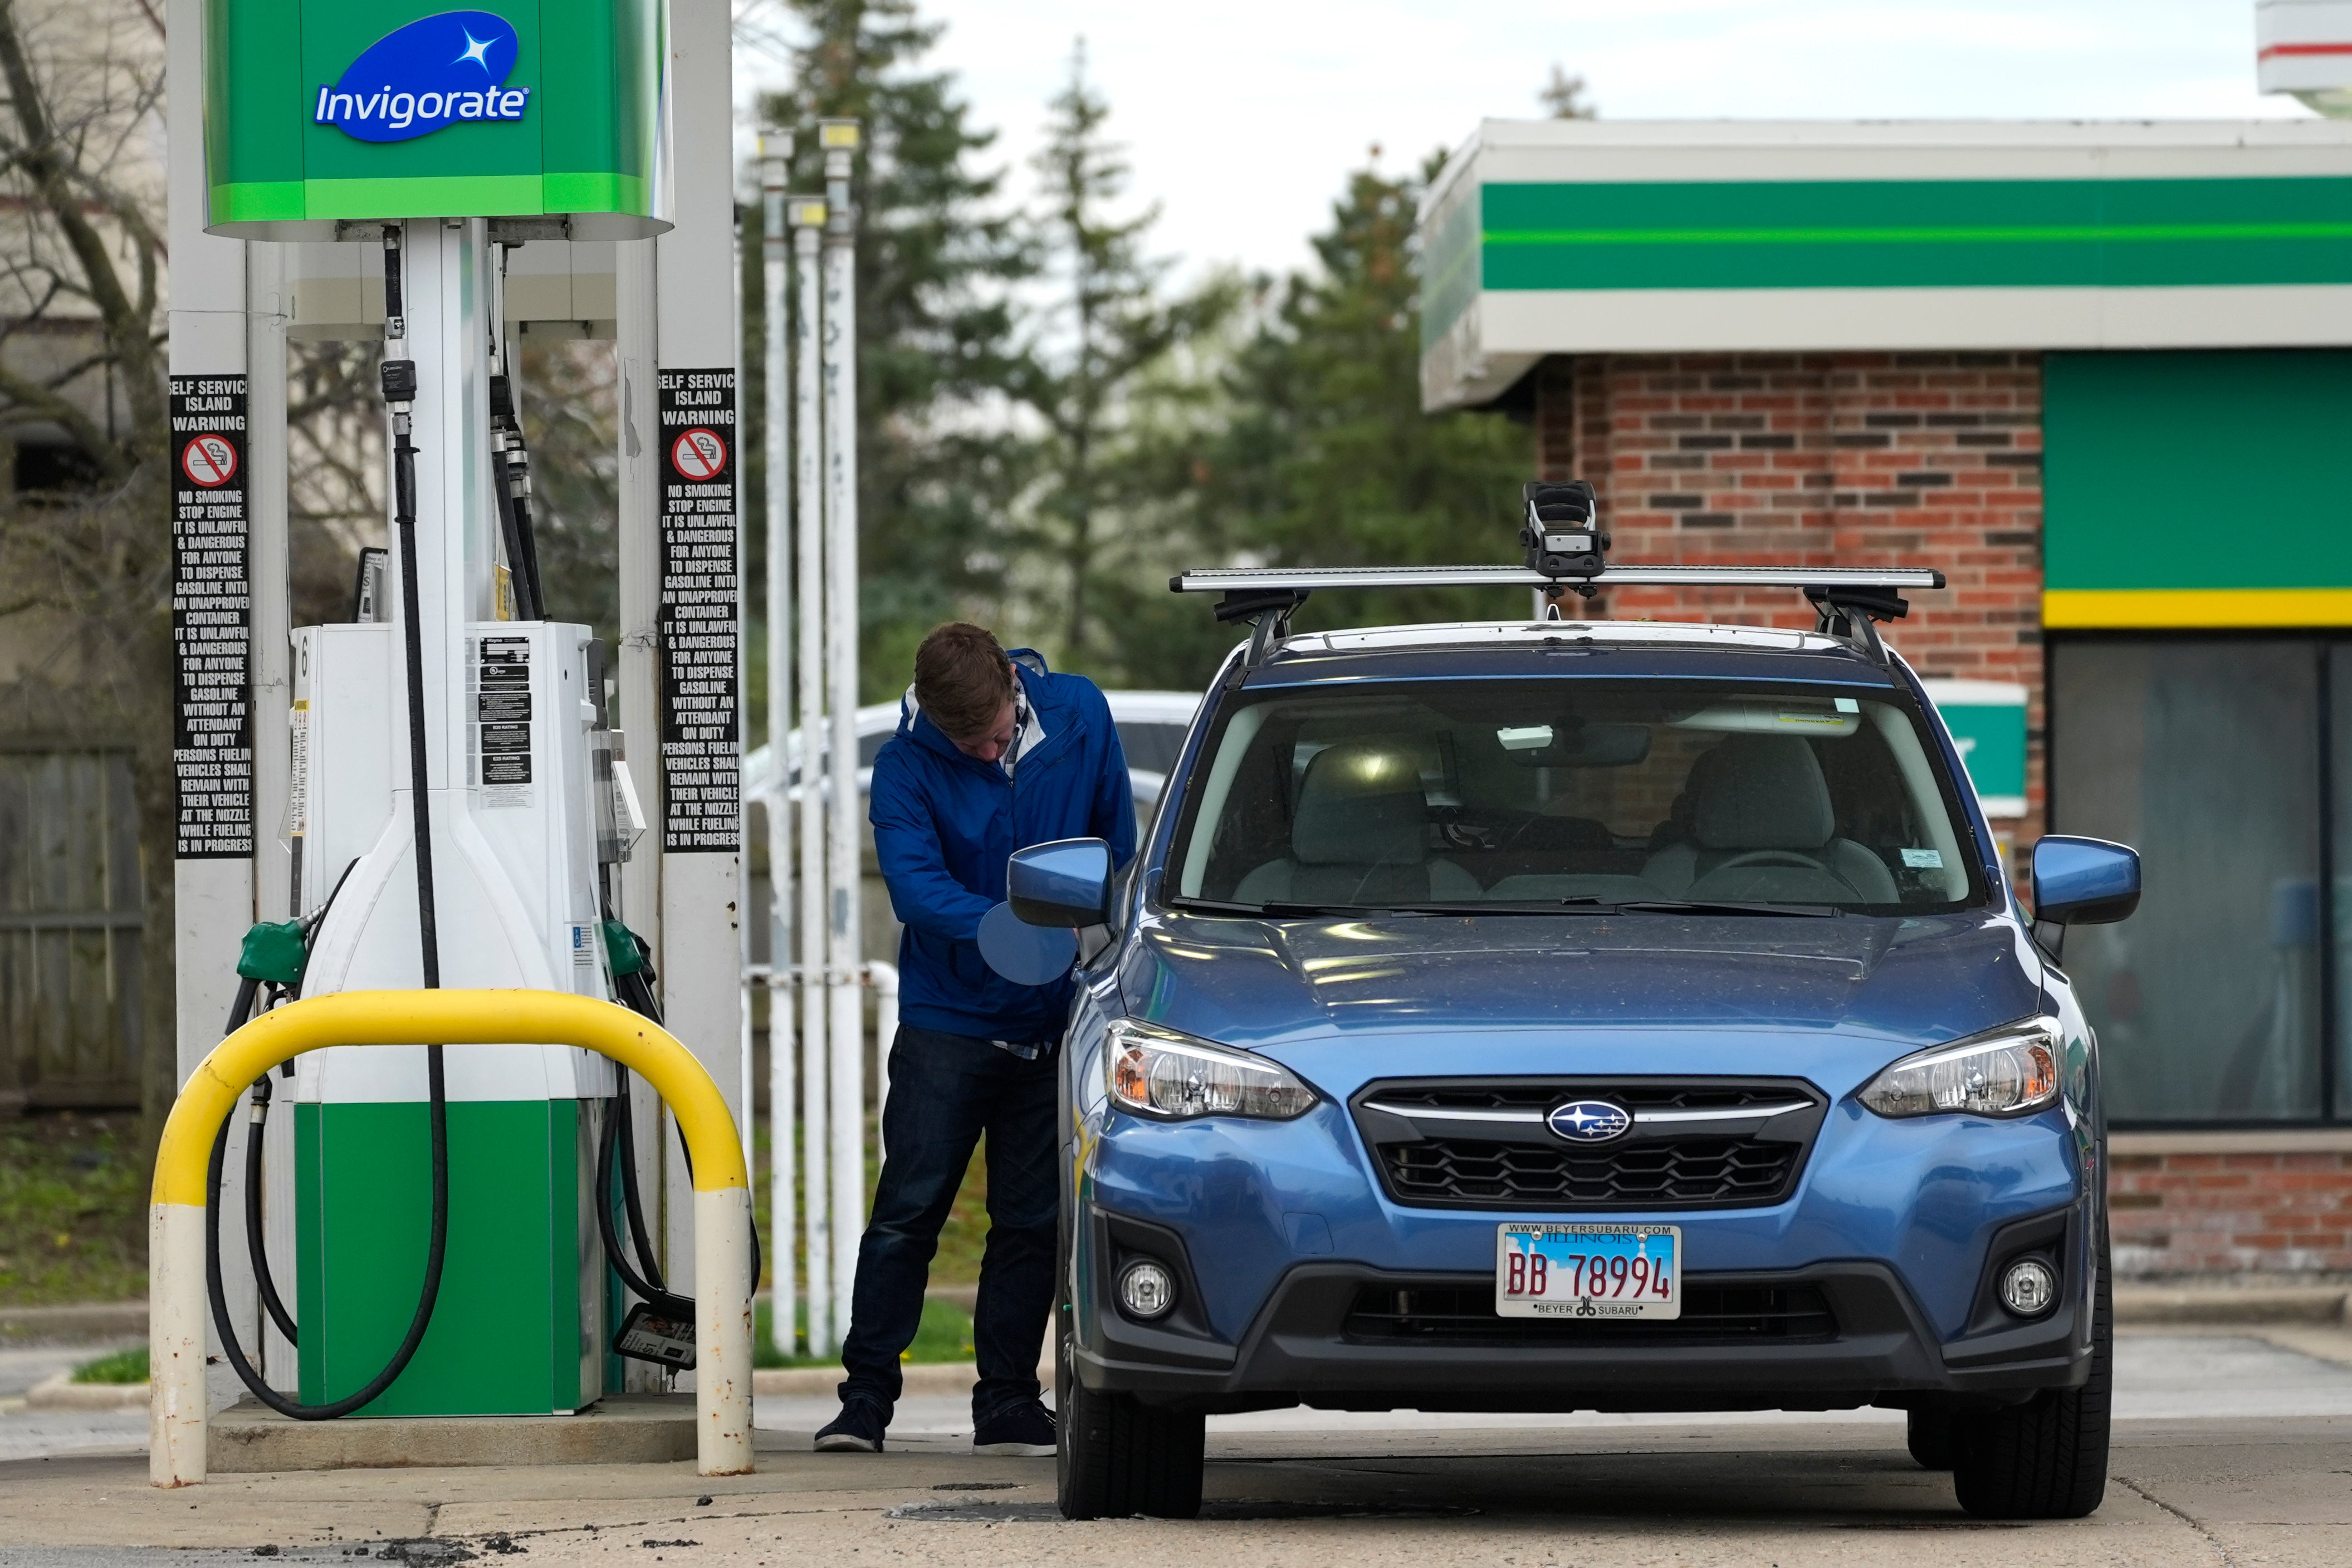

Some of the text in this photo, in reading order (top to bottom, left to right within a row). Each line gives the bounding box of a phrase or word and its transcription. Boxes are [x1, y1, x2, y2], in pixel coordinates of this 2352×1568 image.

[198, 380, 247, 394] SERVIC
[688, 374, 734, 389] SERVIC
[185, 397, 232, 411] ISLAND
[675, 391, 721, 405] ISLAND
[173, 416, 245, 431] WARNING
[662, 410, 734, 425] WARNING
[179, 491, 242, 503] NO SMOKING
[668, 484, 731, 497] NO SMOKING
[668, 499, 731, 512] STOP ENGINE
[179, 506, 242, 519] STOP ENGINE
[662, 514, 736, 527] IT IS UNLAWFUL
[174, 521, 248, 534] IT IS UNLAWFUL
[178, 536, 245, 549] & DANGEROUS
[667, 530, 734, 543] & DANGEROUS
[182, 551, 242, 564] FOR ANYONE
[671, 545, 731, 558] FOR ANYONE
[181, 566, 243, 579] TO DISPENSE
[669, 560, 732, 573] TO DISPENSE
[176, 581, 247, 594] GASOLINE INTO
[664, 575, 736, 589] GASOLINE INTO
[174, 597, 186, 610] AN
[662, 591, 675, 604] AN
[186, 612, 239, 624] CONTAINER
[675, 606, 728, 619] CONTAINER
[175, 627, 249, 640] IT IS UNLAWFUL
[664, 621, 673, 634] IT
[676, 621, 686, 634] IS
[179, 642, 247, 655] & DANGEROUS
[668, 636, 735, 649] & DANGEROUS
[302, 635, 307, 677] 6
[672, 651, 732, 664] FOR ANYONE
[183, 657, 243, 670] FOR ANYONE
[183, 673, 245, 685] TO DISPENSE
[672, 666, 734, 679] TO DISPENSE
[190, 688, 237, 701] GASOLINE
[679, 682, 726, 694] GASOLINE
[672, 696, 734, 709] WITHOUT AN
[183, 703, 245, 716] WITHOUT AN
[187, 718, 242, 731] ATTENDANT
[676, 712, 731, 724] ATTENDANT
[193, 733, 236, 746] ON DUTY
[682, 727, 725, 739] ON DUTY
[663, 742, 705, 755] PERSONS
[174, 749, 216, 762] PERSONS
[177, 763, 251, 777] VEHICLES SHALL
[666, 757, 710, 770] VEHICLES
[181, 778, 249, 792] REMAIN WITH
[670, 772, 737, 785] REMAIN WITH
[181, 793, 249, 806] THEIR VEHICLE
[670, 787, 737, 800] THEIR VEHICLE
[181, 809, 250, 822] AT THE NOZZLE
[670, 802, 738, 816] AT THE NOZZLE
[180, 824, 251, 837] WHILE FUELING
[668, 818, 739, 831] WHILE FUELING
[178, 839, 252, 852] IS IN PROGRESS
[667, 834, 677, 846] IS
[680, 834, 691, 846] IN
[1509, 1224, 1671, 1234] WWW.BEYERSUBARU.COM
[1508, 1252, 1670, 1299] BB 78994
[1538, 1305, 1638, 1315] BEYER SUBARU
